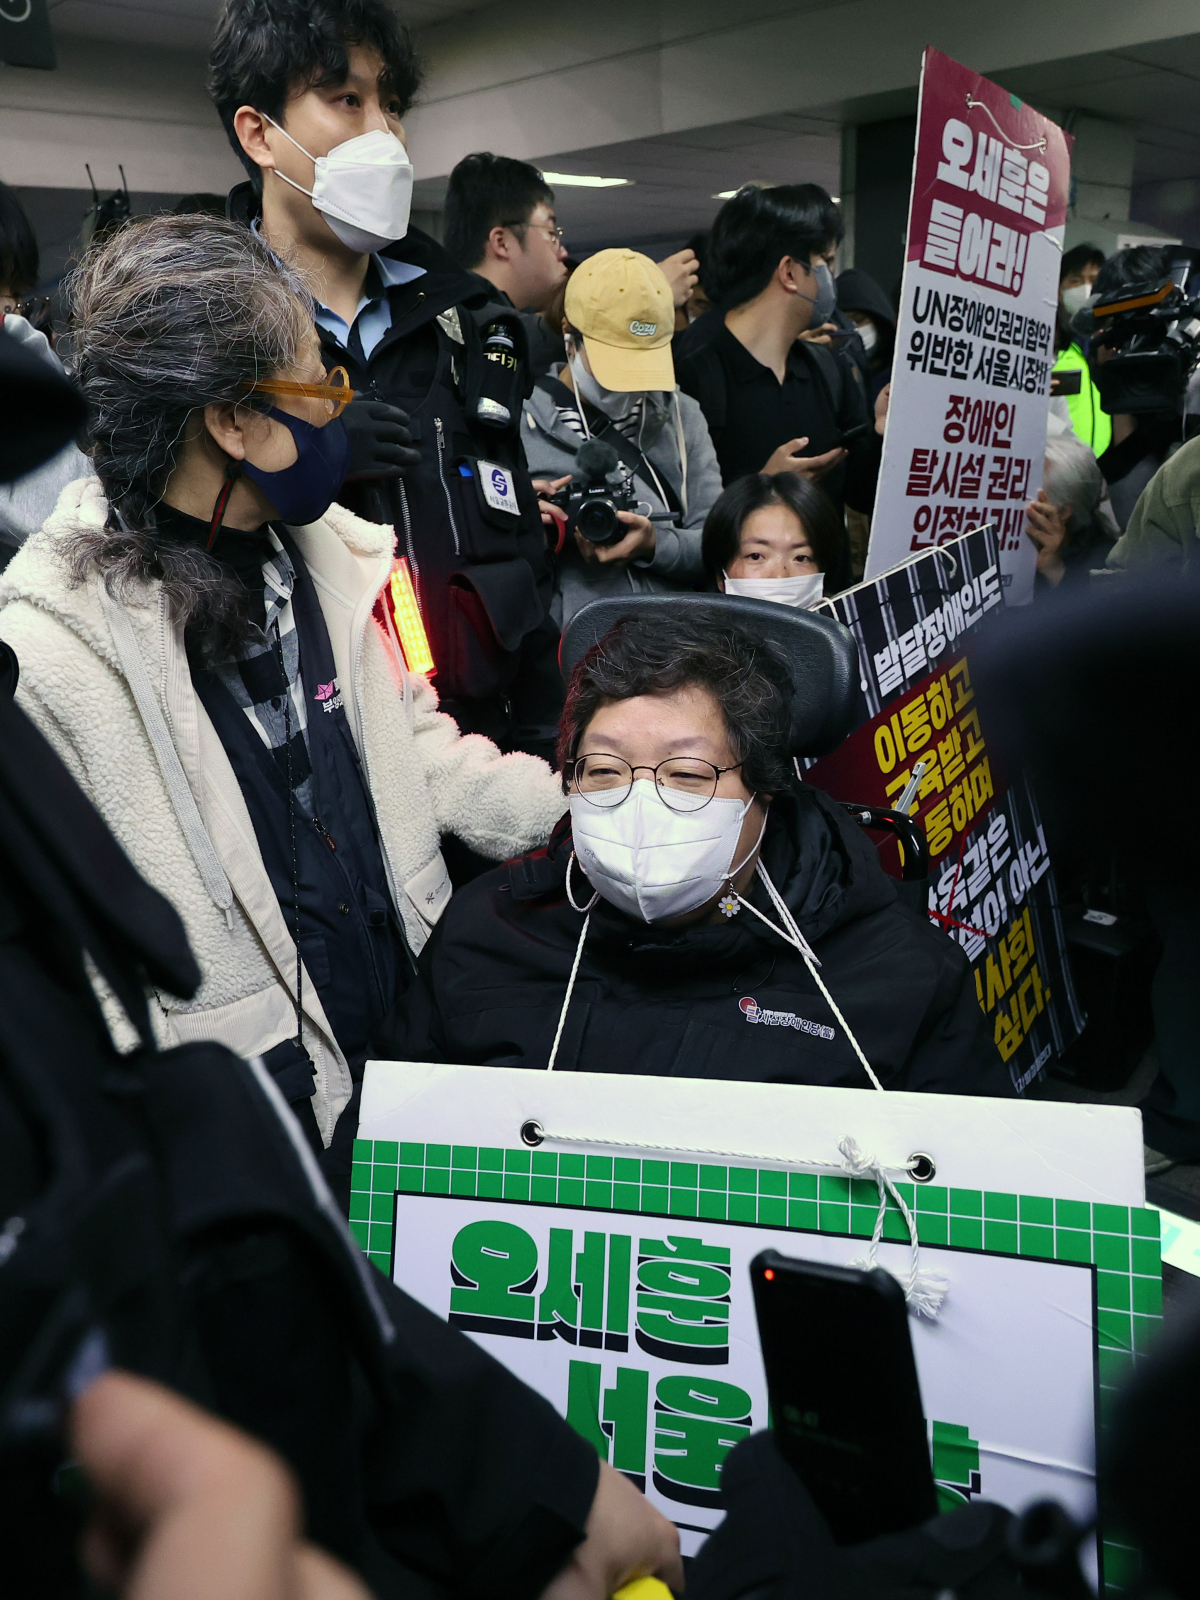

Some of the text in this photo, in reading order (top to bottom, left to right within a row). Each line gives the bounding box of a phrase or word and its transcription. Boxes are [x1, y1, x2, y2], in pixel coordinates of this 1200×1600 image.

[937, 118, 1051, 225] 오세훈은
[923, 198, 1028, 292] 들어라!
[629, 320, 657, 336] Cozy
[907, 330, 1049, 395] 위반한 서울시장!!
[912, 286, 1051, 356] UN장애인권리협약
[905, 448, 1031, 501] 탈시설 권리
[943, 394, 1016, 449] 장애인
[873, 564, 1002, 698] 발달장애인도
[873, 655, 975, 774] 이동하고
[898, 755, 994, 868] 동하며
[947, 824, 1051, 963] 설이 아닌
[973, 906, 1037, 1015] 사회
[448, 1219, 732, 1366] 오세훈
